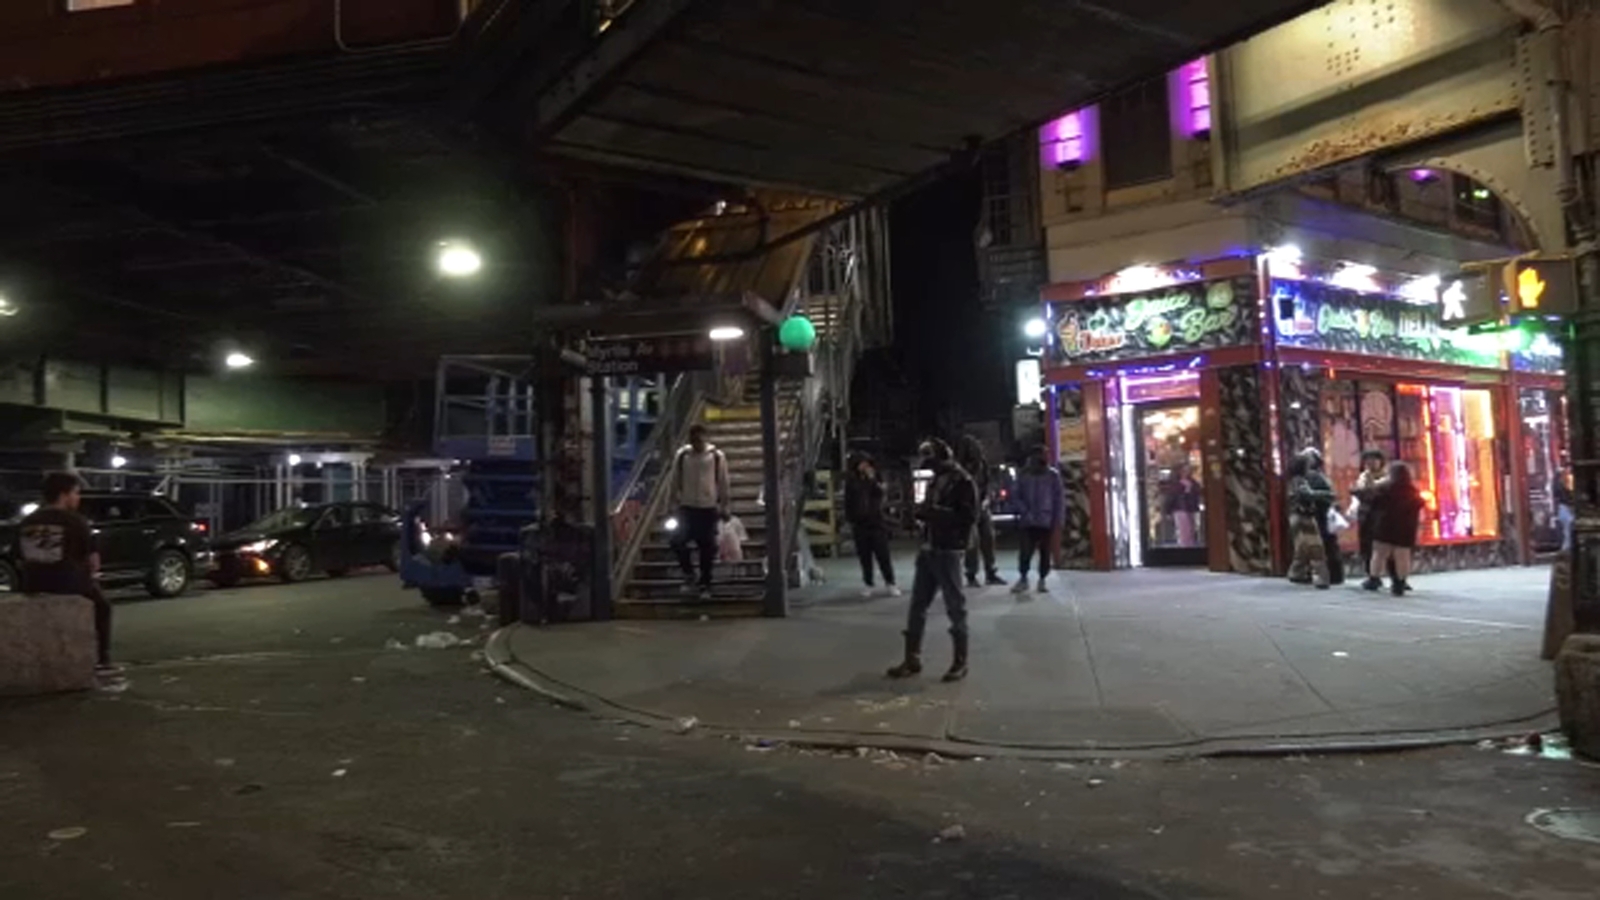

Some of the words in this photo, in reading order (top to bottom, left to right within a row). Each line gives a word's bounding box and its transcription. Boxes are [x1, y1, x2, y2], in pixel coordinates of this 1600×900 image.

[1181, 306, 1237, 343] Bar
[587, 343, 631, 358] Myrtle
[636, 342, 654, 356] Av
[587, 359, 639, 373] Station
